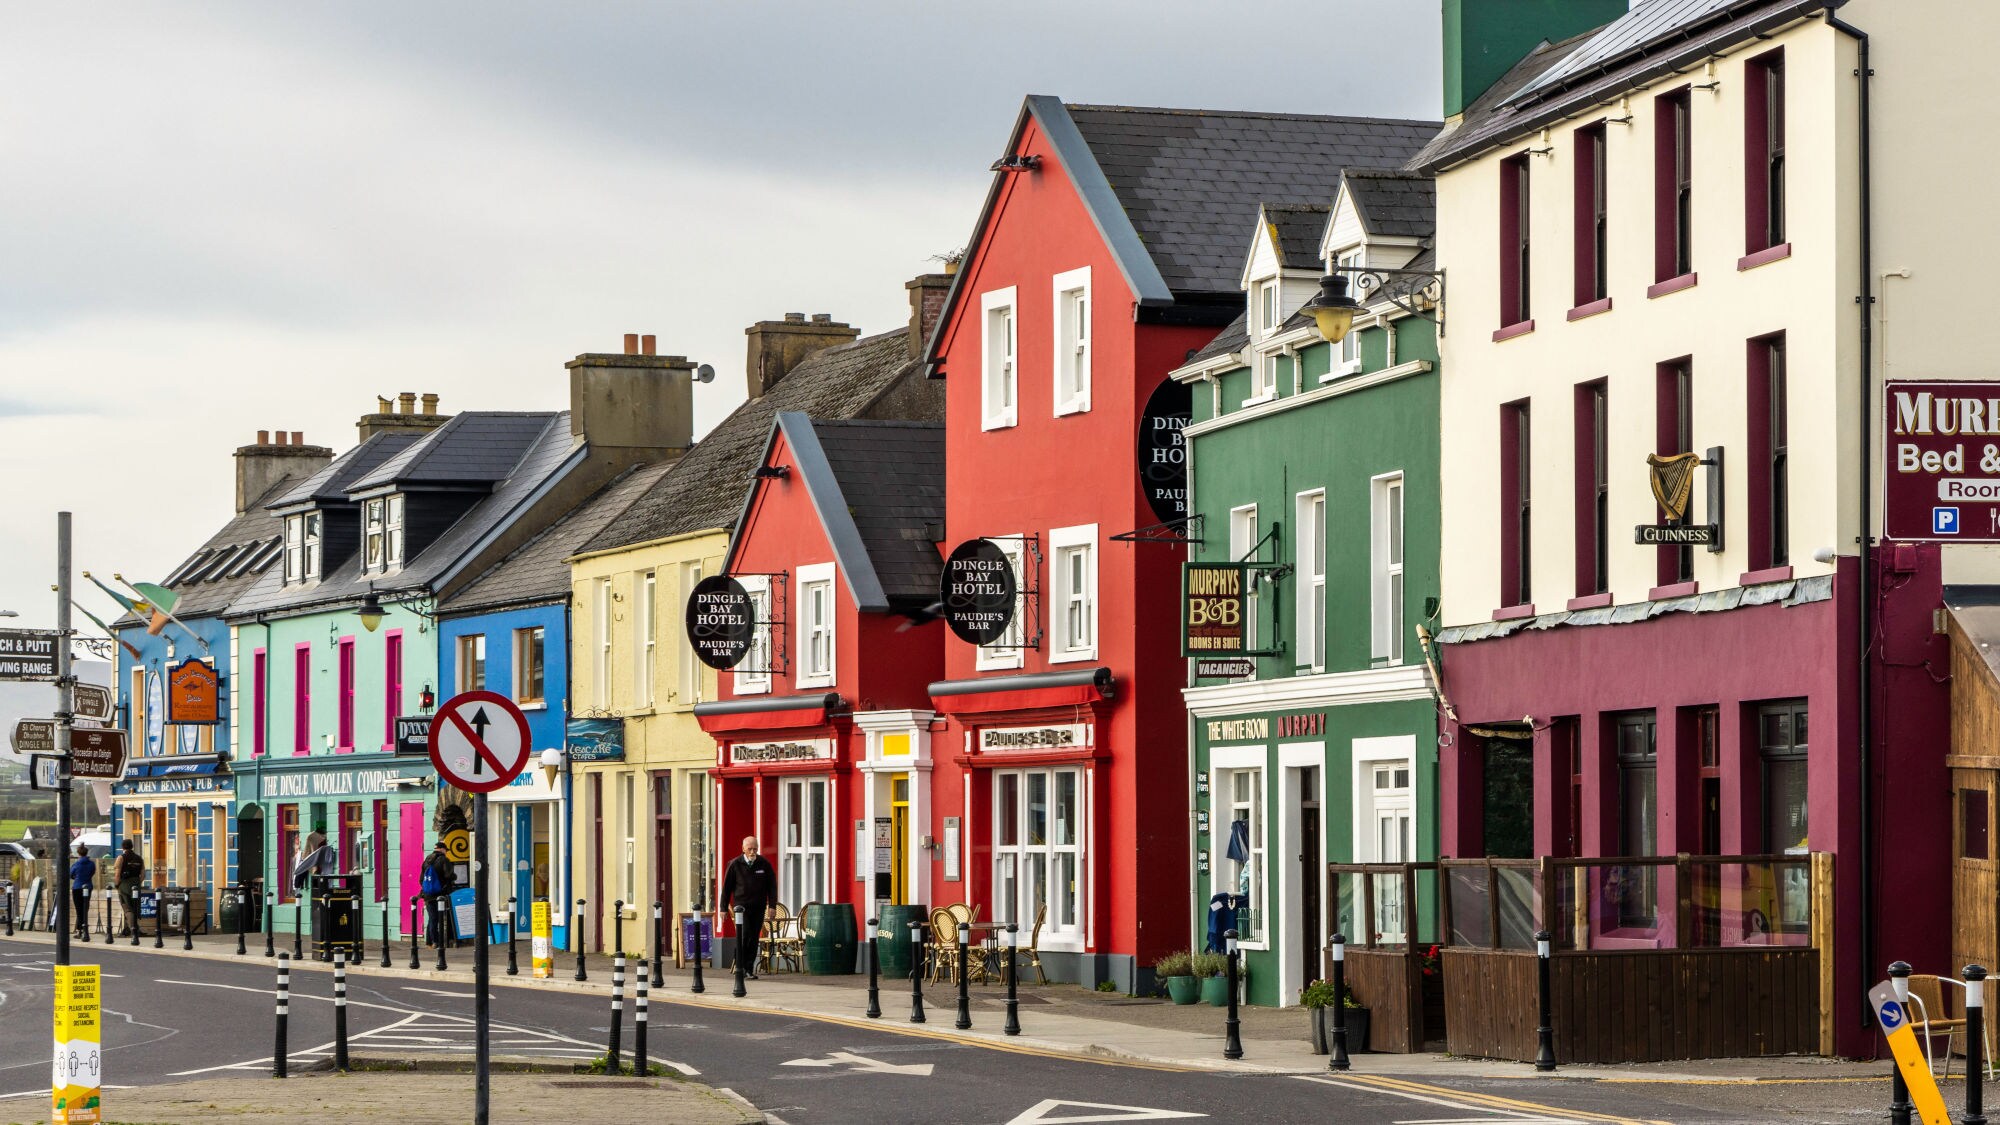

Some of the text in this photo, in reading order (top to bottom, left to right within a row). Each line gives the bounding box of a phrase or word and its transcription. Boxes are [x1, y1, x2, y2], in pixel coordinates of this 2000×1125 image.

[1898, 443, 2000, 473] Bed &
[1938, 511, 1953, 530] P
[1643, 527, 1709, 542] GUINNESS
[952, 560, 1004, 571] DINGLE
[965, 572, 991, 582] BAY
[1189, 568, 1239, 595] MURPHYS
[951, 583, 1005, 595] HOTEL
[697, 594, 745, 604] DINGLE
[710, 604, 732, 614] BAY
[1188, 597, 1240, 625] B&B
[696, 614, 746, 625] HOTEL
[954, 612, 1004, 621] PAUDIE'S
[968, 621, 990, 630] BAR
[16, 639, 23, 652] &
[26, 640, 52, 653] PUTT
[699, 640, 745, 649] PAUDIE'S
[1189, 637, 1240, 649] ROOMS EN SUITE
[712, 648, 732, 656] BAR
[22, 662, 53, 674] RANGE
[1198, 663, 1250, 675] VACANCIES
[1207, 718, 1268, 741] THE WHITE ROOM
[19, 740, 54, 749] DINGLE WAY
[73, 759, 90, 774] Dingle
[137, 778, 212, 793] JOHN BENNY'S PUB
[263, 769, 400, 797] THE DINGLE WOOLLEN COMPANY
